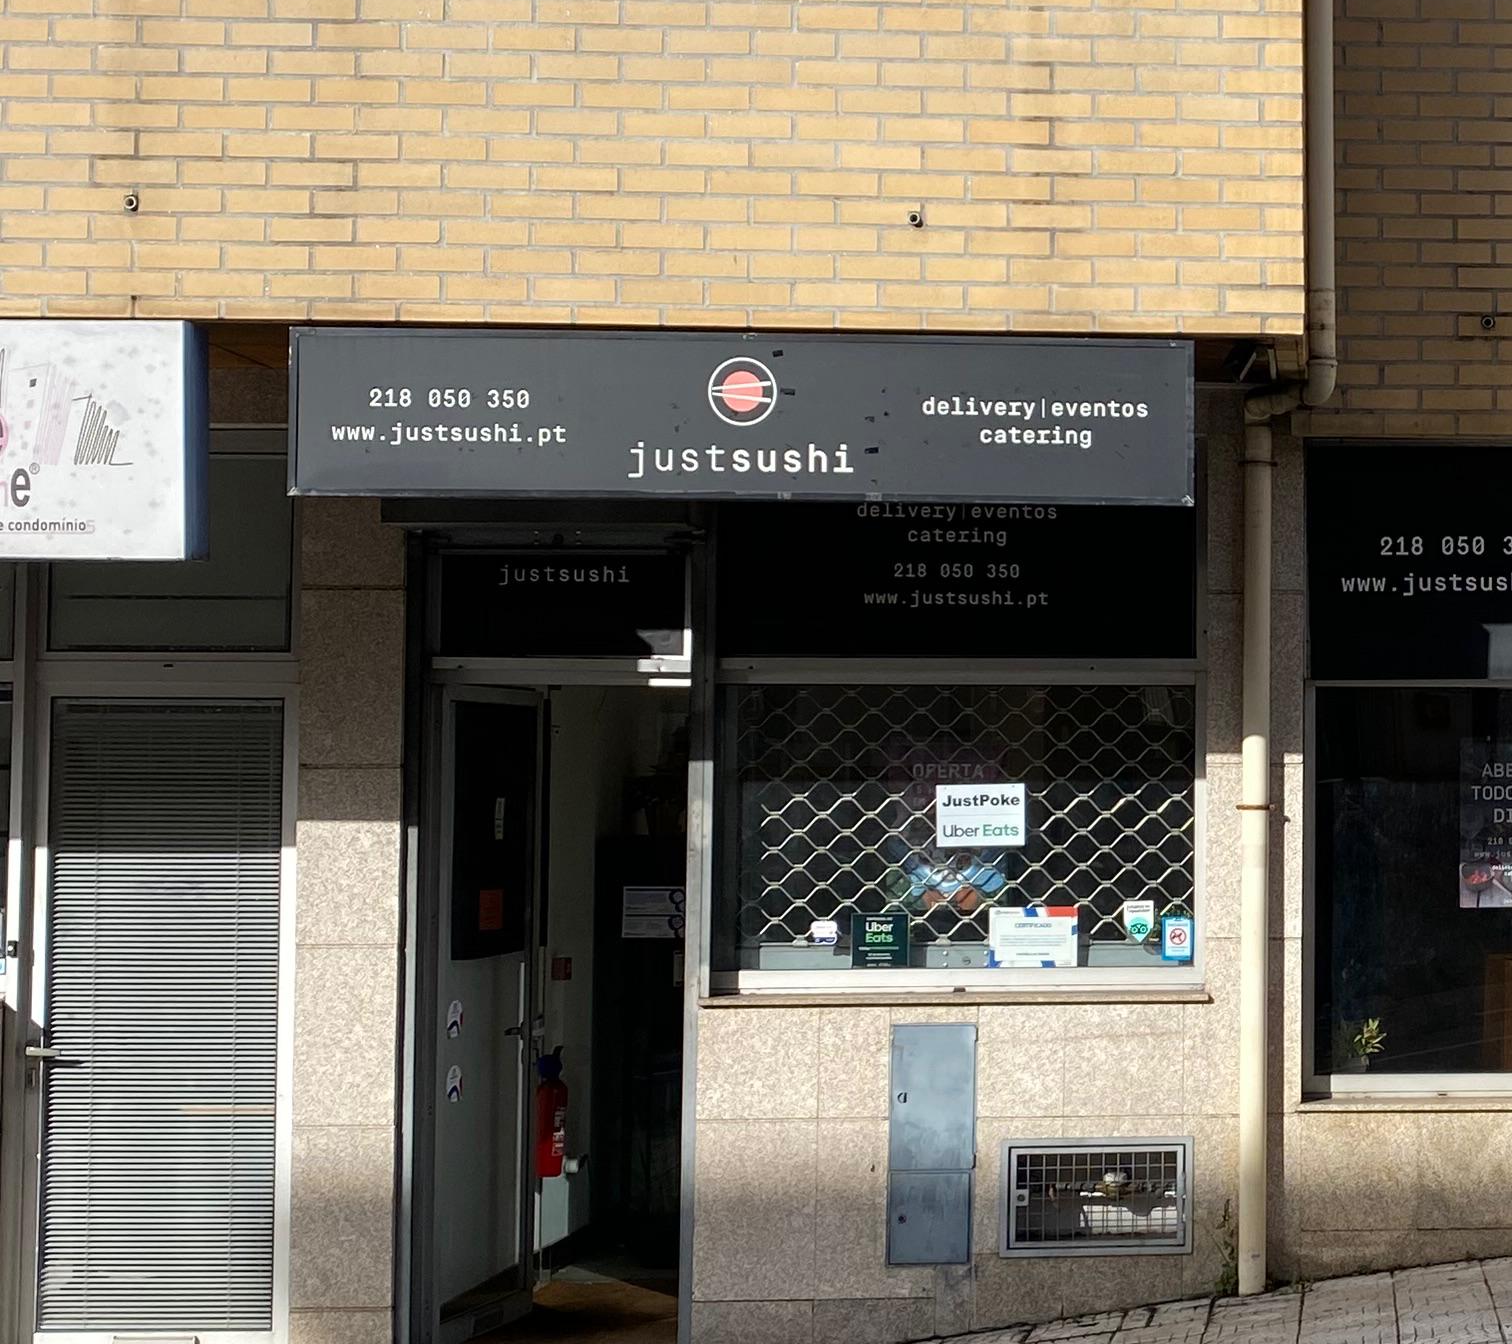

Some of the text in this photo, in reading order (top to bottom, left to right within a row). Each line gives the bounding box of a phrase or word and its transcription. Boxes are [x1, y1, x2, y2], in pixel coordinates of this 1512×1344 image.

[368, 388, 530, 410] 218 050 350
[331, 422, 567, 446] www.justsushi.pt
[979, 425, 1093, 449] catering
[627, 441, 855, 479] justsushi
[907, 525, 1007, 546] catering
[1379, 536, 1424, 556] 218
[1441, 536, 1485, 556] 050
[499, 564, 631, 586] justsushi
[893, 563, 1020, 579] 218 050 350
[863, 589, 1049, 608] www.justsushi.pt
[912, 763, 985, 779] OFERTA
[942, 794, 1021, 807] JustPoke
[943, 823, 1020, 838] Uber Eats
[865, 921, 894, 932] Uber
[865, 932, 894, 943] Eats
